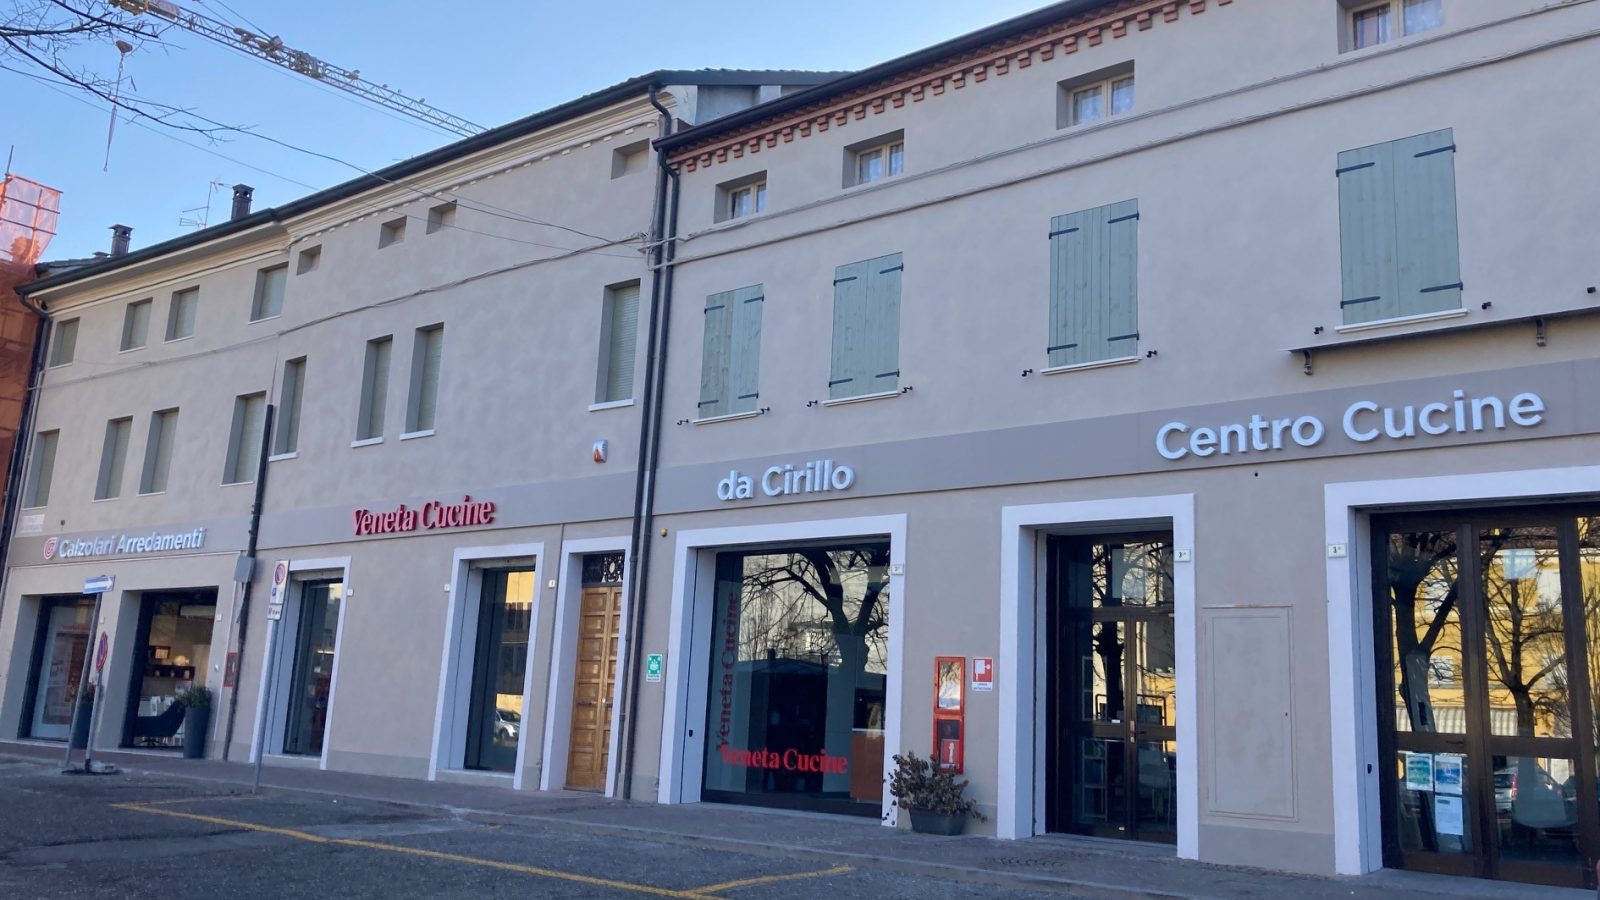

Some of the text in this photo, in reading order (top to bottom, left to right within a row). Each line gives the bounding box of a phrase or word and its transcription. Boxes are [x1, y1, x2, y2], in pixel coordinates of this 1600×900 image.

[1156, 389, 1546, 460] Centro Cucine
[717, 459, 856, 501] da Cirillo
[353, 495, 496, 535] Veneta Cucine
[58, 528, 206, 558] Calzolari Arredamenti
[716, 674, 735, 751] Veneta
[719, 743, 848, 773] Veneta Cucine
